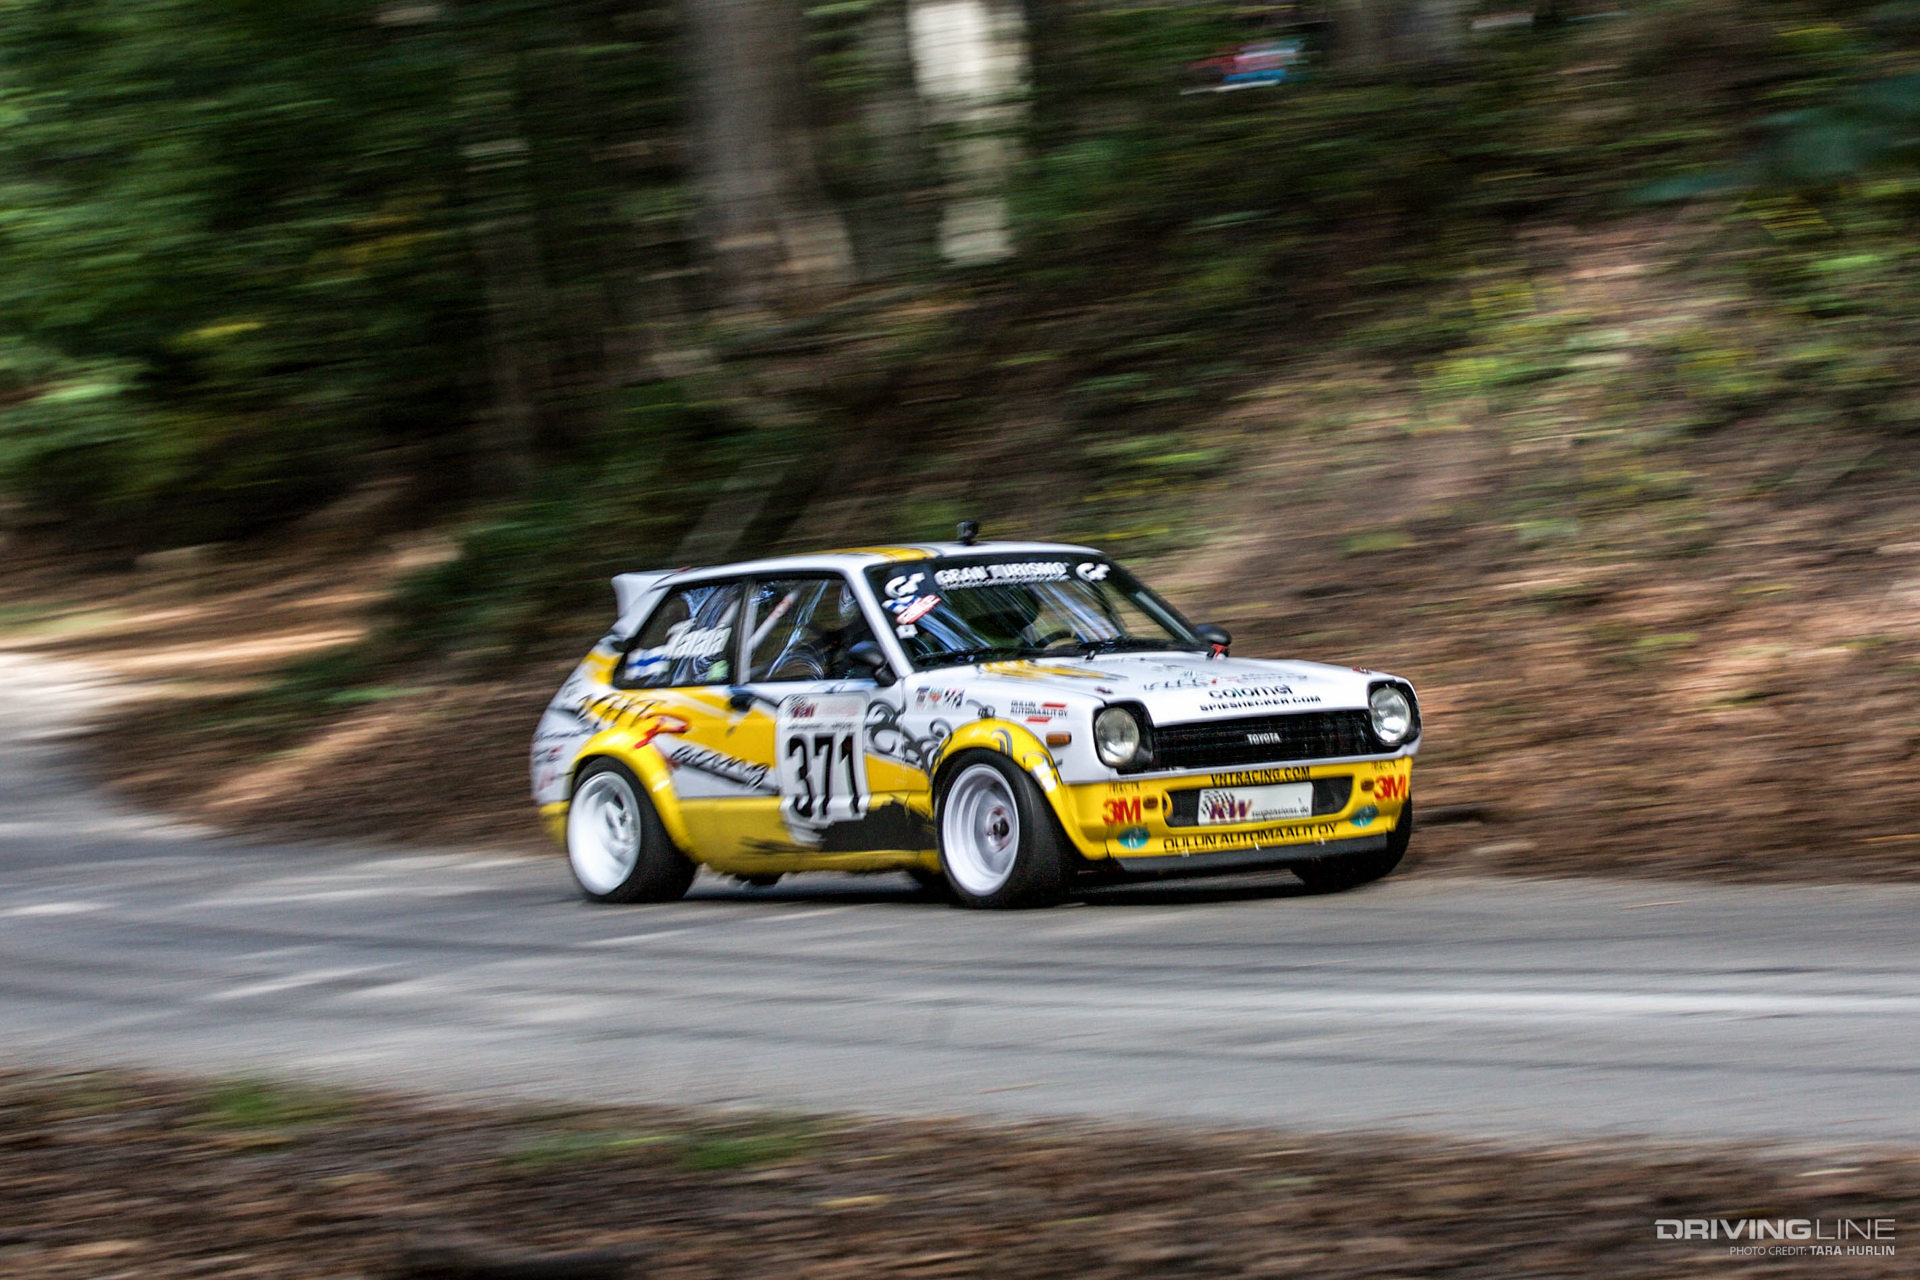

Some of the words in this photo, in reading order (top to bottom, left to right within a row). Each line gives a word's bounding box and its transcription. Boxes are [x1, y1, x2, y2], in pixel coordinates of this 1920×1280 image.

[934, 566, 988, 585] GRAN
[1247, 732, 1281, 745] TOYOTA
[786, 732, 859, 819] 371
[1374, 774, 1406, 800] 3M
[1102, 796, 1142, 825] 3M
[1219, 825, 1313, 845] AUTOMAALIT
